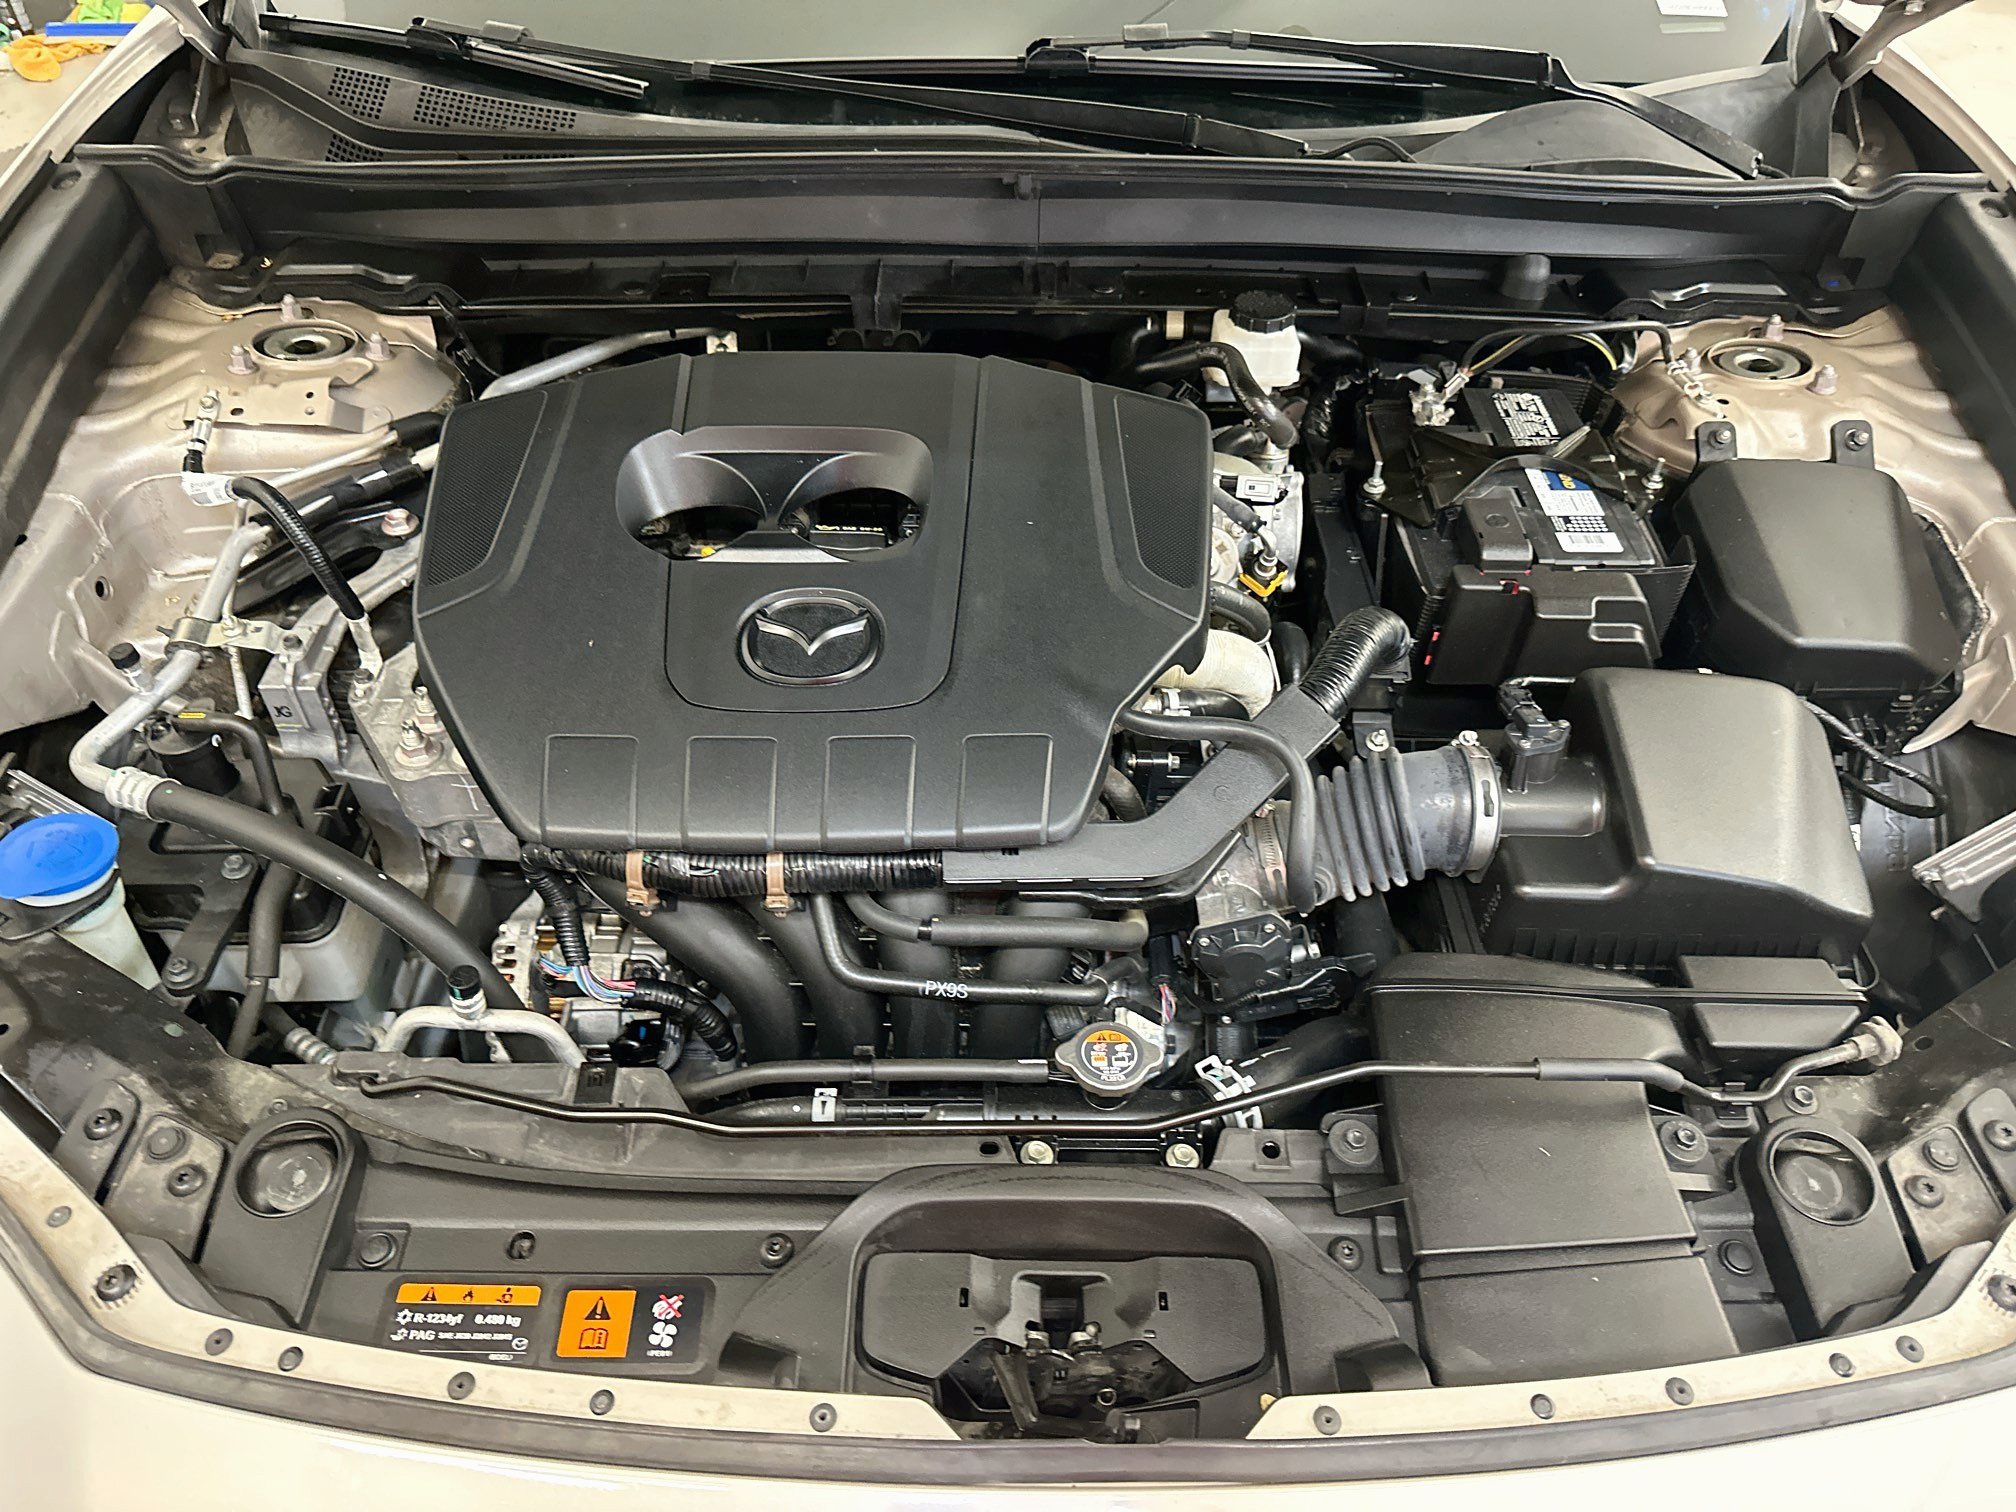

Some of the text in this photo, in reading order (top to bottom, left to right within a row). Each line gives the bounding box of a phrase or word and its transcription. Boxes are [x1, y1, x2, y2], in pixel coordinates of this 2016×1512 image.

[925, 980, 969, 999] PX9S
[413, 1312, 464, 1326] R-1234yf
[506, 1314, 522, 1328] kg
[408, 1329, 436, 1341] PAG
